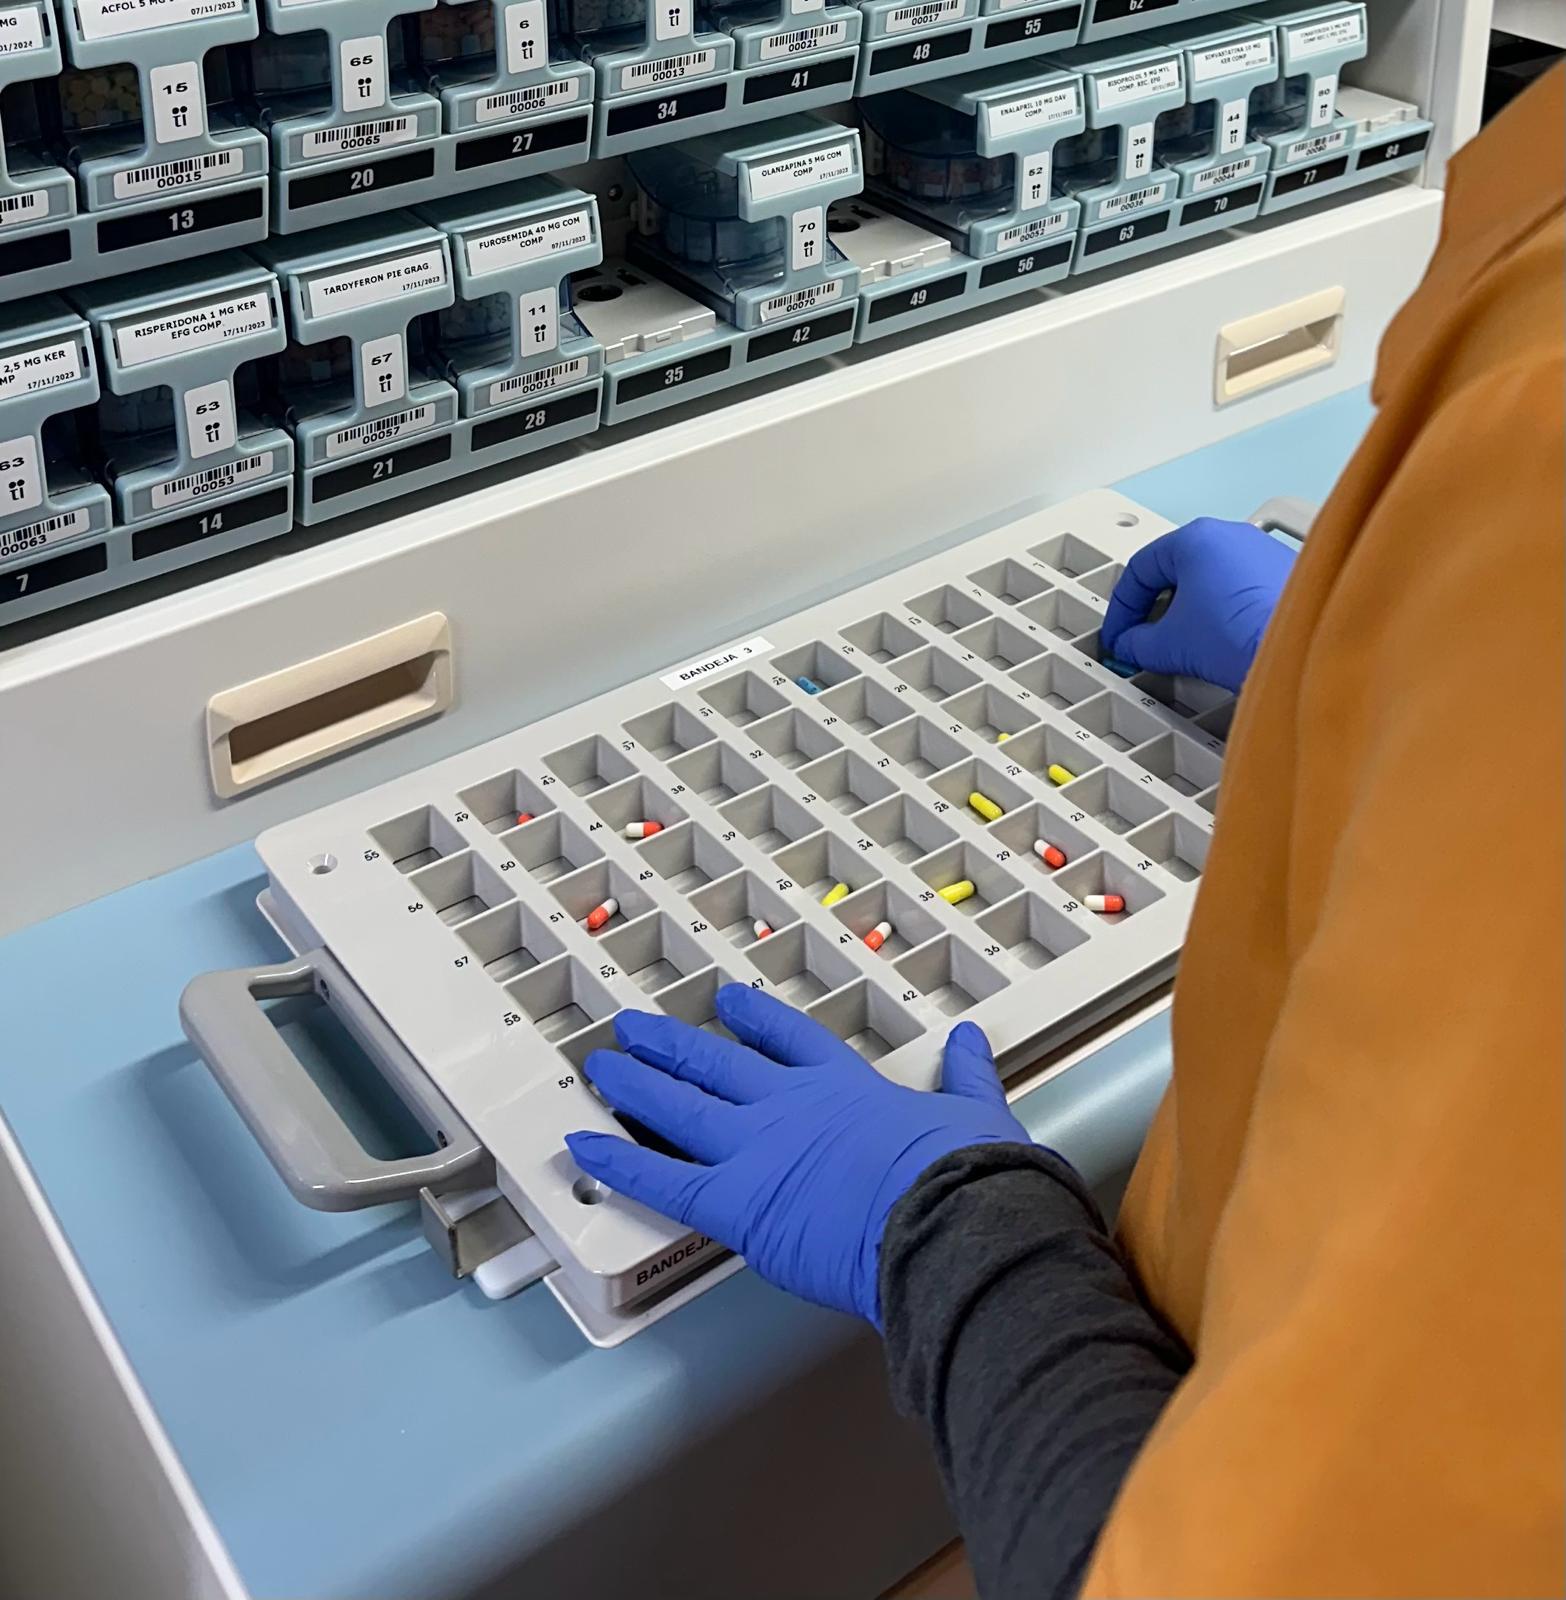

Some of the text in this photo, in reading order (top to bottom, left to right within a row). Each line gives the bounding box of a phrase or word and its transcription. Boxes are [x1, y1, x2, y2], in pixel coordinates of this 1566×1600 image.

[101, 1, 136, 15] ACFOL
[190, 1, 236, 16] 07/11/2023
[0, 18, 17, 27] MG
[519, 20, 530, 29] 6
[911, 13, 939, 26] 00017
[1024, 18, 1042, 36] 55
[788, 39, 818, 52] 00021
[912, 43, 931, 61] 48
[350, 55, 374, 67] 65
[652, 67, 685, 82] 00013
[790, 71, 809, 88] 41
[1107, 75, 1142, 88] BISOPROLOL
[162, 82, 189, 95] 15
[510, 98, 546, 114] 00006
[657, 100, 678, 120] 34
[1000, 94, 1067, 116] ENALAPRIL 10 MG DAV
[1227, 113, 1240, 121] 44
[341, 135, 381, 150] 00065
[512, 132, 534, 154] 27
[1133, 137, 1146, 146] 36
[761, 160, 807, 177] OLANZAPINA
[814, 155, 826, 163] MG
[826, 150, 842, 160] COM
[793, 167, 813, 177] COMP
[819, 167, 849, 180] 17/11/2023
[1303, 169, 1317, 185] 77
[157, 171, 202, 189] 00015
[350, 168, 375, 190] 20
[1120, 199, 1144, 211] 00036
[1214, 197, 1228, 212] 70
[169, 209, 195, 232] 13
[479, 216, 580, 249] FUROSEMIDA 40 MG COM
[799, 222, 816, 233] 70
[1119, 225, 1134, 241] 63
[1019, 228, 1045, 242] 00052
[519, 236, 544, 248] COMP
[551, 235, 586, 250] 07/11/2023
[1017, 257, 1034, 273] 56
[323, 273, 384, 296] TARDYFERON
[386, 269, 402, 280] PIE
[402, 275, 440, 291] 17/11/2023
[910, 289, 927, 306] 49
[528, 304, 546, 316] 11
[786, 297, 816, 312] 00070
[134, 300, 257, 338] RISPERIDONA 1 MG KER
[171, 328, 190, 339] EFG
[223, 320, 266, 337] 17/11/2023
[792, 326, 811, 343] 42
[4, 350, 66, 373] 2,5 MG KER
[371, 352, 393, 366] 57
[28, 371, 75, 390] 17/11/2023
[664, 366, 684, 385] 35
[522, 378, 556, 394] 00011
[195, 401, 221, 415] 53
[524, 410, 546, 430] 28
[362, 425, 400, 445] 00057
[372, 457, 394, 479] 21
[192, 475, 235, 496] 00053
[199, 512, 223, 534] 14
[1, 534, 47, 556] 00063
[16, 573, 29, 592] 7
[962, 653, 975, 662] 14
[679, 653, 738, 681] BANDEJA
[773, 676, 787, 686] 25
[894, 684, 908, 693] 20
[1017, 692, 1031, 700] 15
[700, 707, 713, 717] 31
[823, 716, 837, 726] 26
[950, 724, 963, 733] 21
[1077, 732, 1090, 741] 16
[623, 741, 636, 751] 37
[750, 750, 764, 759] 32
[877, 758, 890, 768] 27
[1007, 765, 1022, 776] 22
[542, 776, 556, 786] 43
[1140, 774, 1153, 784] 17
[671, 785, 686, 795] 38
[802, 793, 817, 804] 33
[935, 802, 950, 813] 28
[456, 812, 469, 823] 49
[1070, 812, 1085, 822] 23
[589, 822, 603, 832] 44
[722, 831, 736, 841] 39
[858, 840, 873, 851] 34
[364, 851, 380, 862] 55
[996, 850, 1011, 861] 29
[500, 860, 516, 872] 50
[1137, 860, 1153, 870] 24
[639, 870, 653, 881] 45
[778, 880, 793, 891] 40
[919, 891, 934, 902] 35
[407, 902, 424, 913] 56
[1063, 901, 1079, 912] 30
[549, 911, 565, 923] 51
[693, 922, 708, 934] 46
[839, 933, 853, 944] 41
[984, 945, 1000, 956] 36
[454, 955, 469, 968] 57
[600, 966, 617, 979] 52
[752, 977, 764, 989] 47
[902, 990, 918, 1002] 42
[503, 1013, 521, 1026] 58
[558, 1075, 575, 1089] 59
